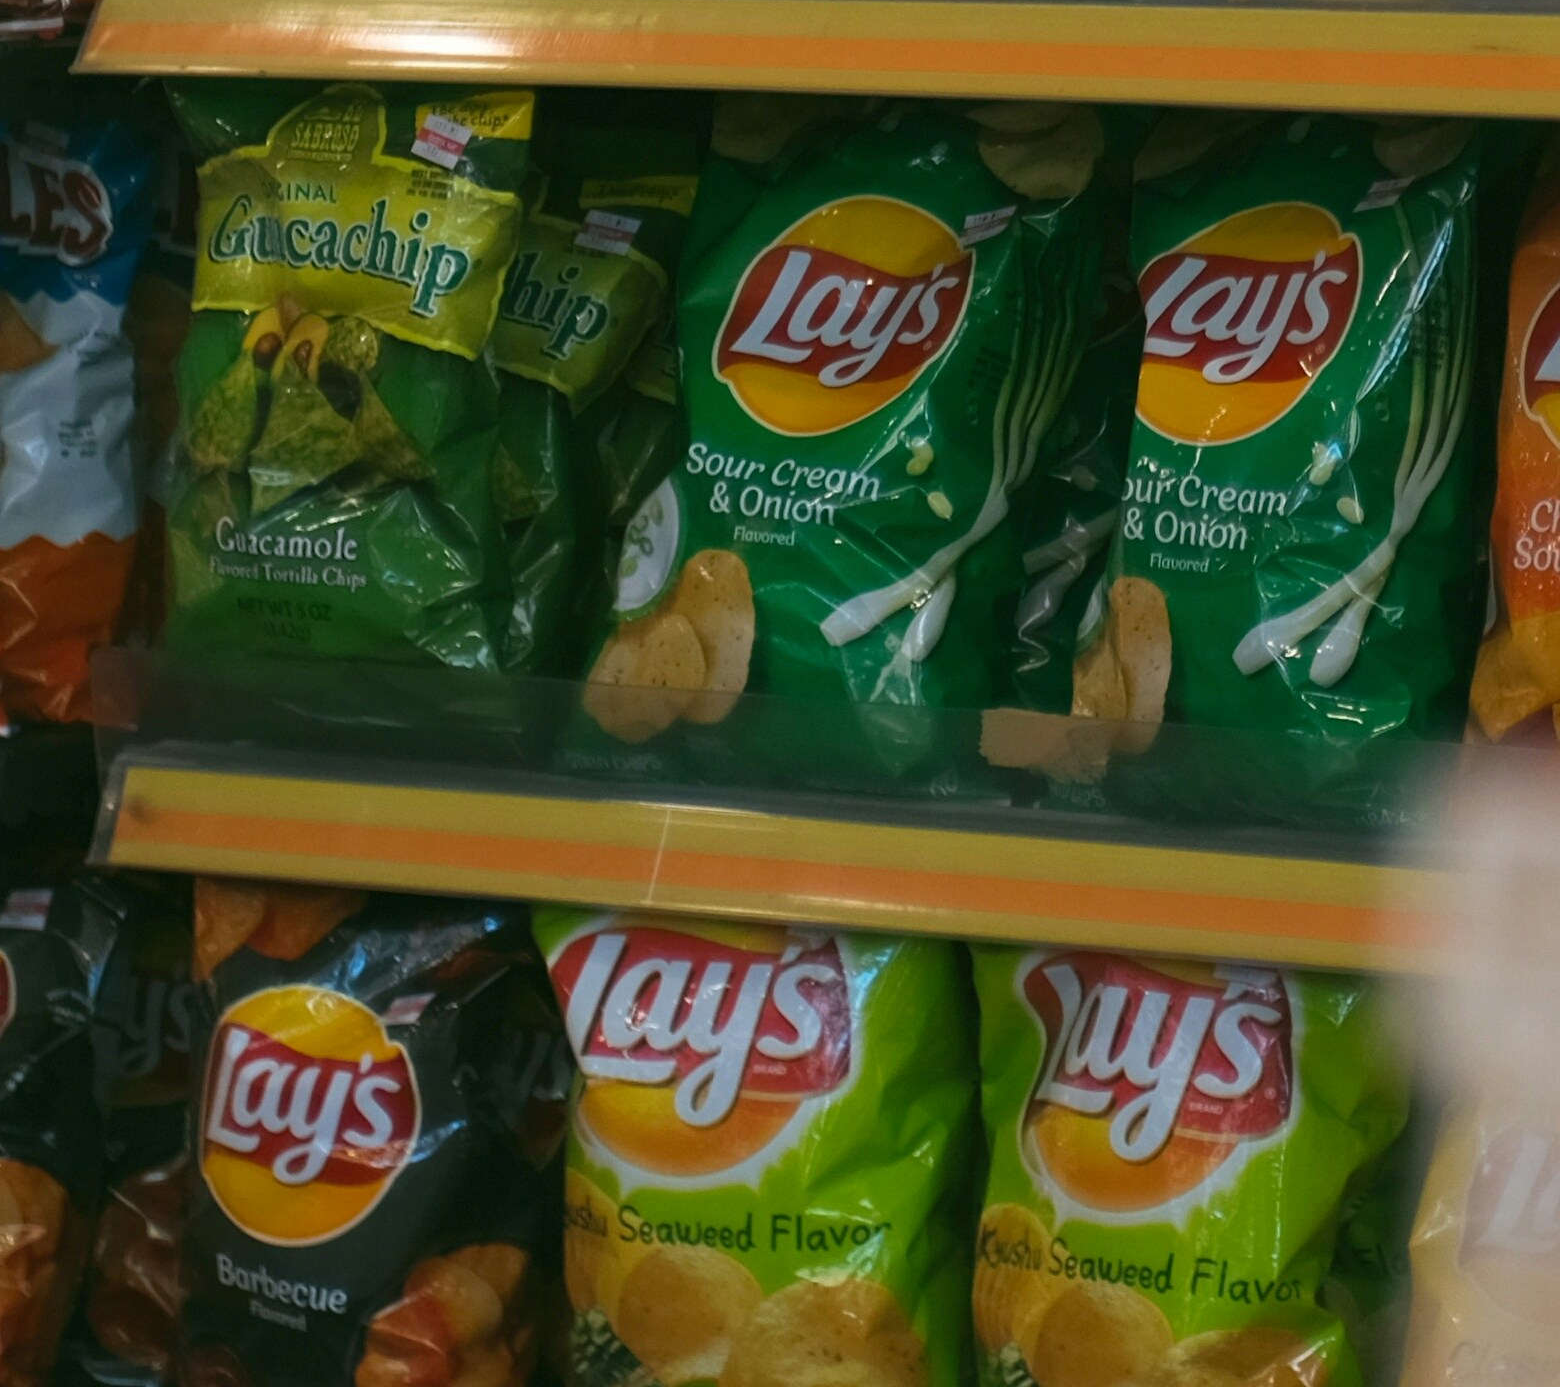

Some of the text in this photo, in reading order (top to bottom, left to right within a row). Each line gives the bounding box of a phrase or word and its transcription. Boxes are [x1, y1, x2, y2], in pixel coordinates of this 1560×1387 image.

[209, 193, 471, 318] Gucachip
[729, 250, 959, 388] Lay's
[1144, 250, 1348, 385] Lay's
[686, 443, 880, 502] Sour Cream
[1178, 474, 1286, 516] Cream
[709, 481, 836, 526] & Onion
[215, 515, 358, 561] Guacamole
[733, 525, 796, 548] Flavored
[1123, 507, 1248, 551] & Onion
[209, 555, 367, 593] Flavored Tortilla Chips
[1149, 552, 1210, 574] Flavored
[566, 934, 831, 1129] Lay's
[753, 1063, 788, 1076] BRAND
[1040, 965, 1282, 1163] Lay's
[206, 1026, 405, 1186] Lay's
[1188, 1101, 1225, 1117] BRAND
[618, 1210, 892, 1252] Seaweed Flavor
[215, 1252, 350, 1315] Barbecue
[1045, 1234, 1174, 1297] Seaweed
[1191, 1258, 1305, 1307] Flavor
